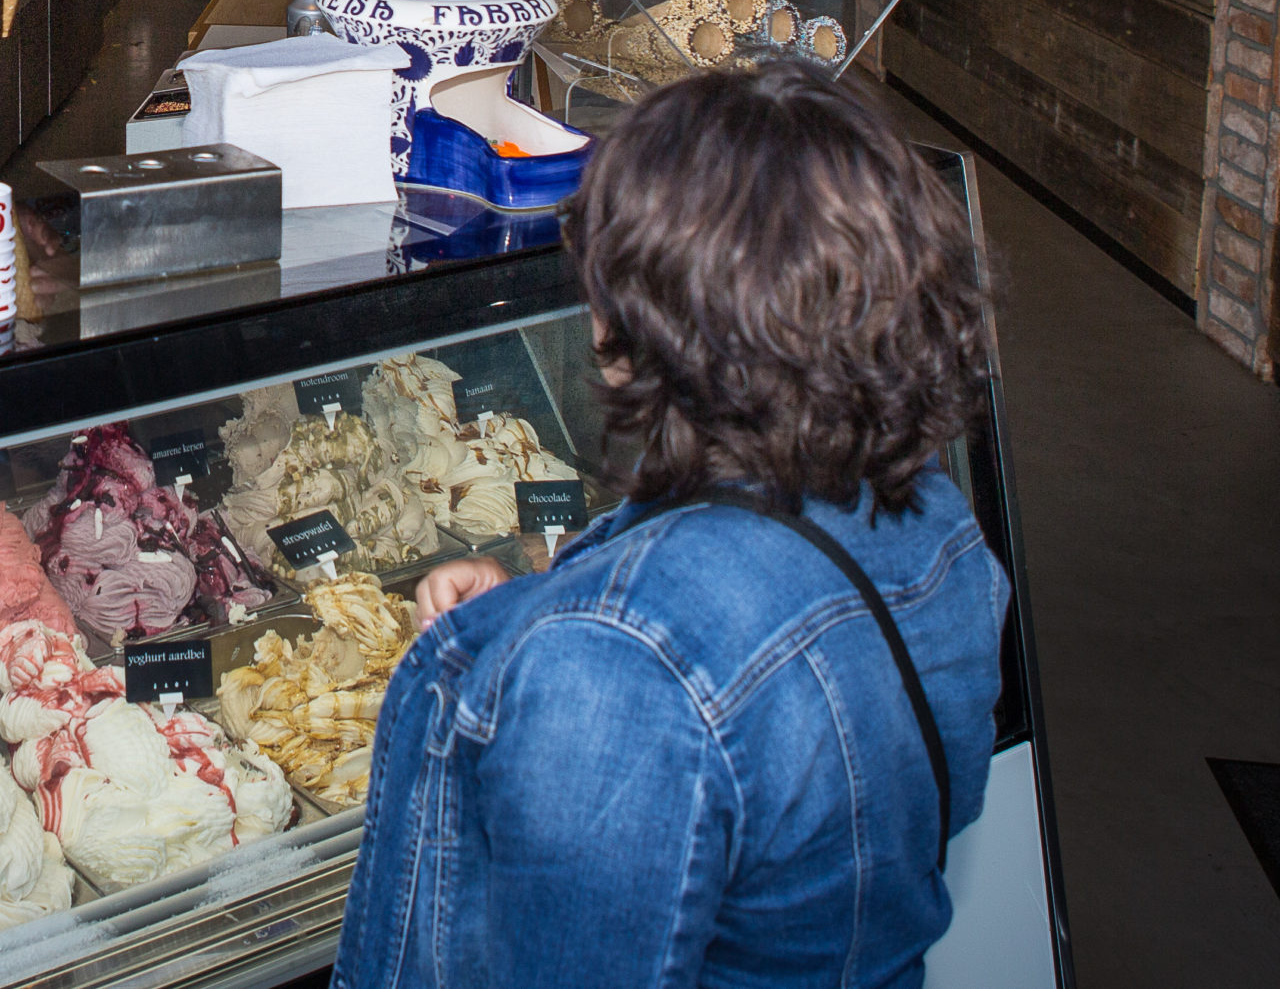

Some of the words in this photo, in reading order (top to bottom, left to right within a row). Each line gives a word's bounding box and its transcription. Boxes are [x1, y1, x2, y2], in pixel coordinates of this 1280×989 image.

[465, 384, 494, 397] banaan
[152, 447, 182, 460] amarene
[182, 442, 204, 452] kersen
[528, 492, 571, 503] chocolade
[282, 520, 333, 546] stroopwafel
[128, 651, 166, 667] yoghurt
[169, 647, 205, 661] aardbei
